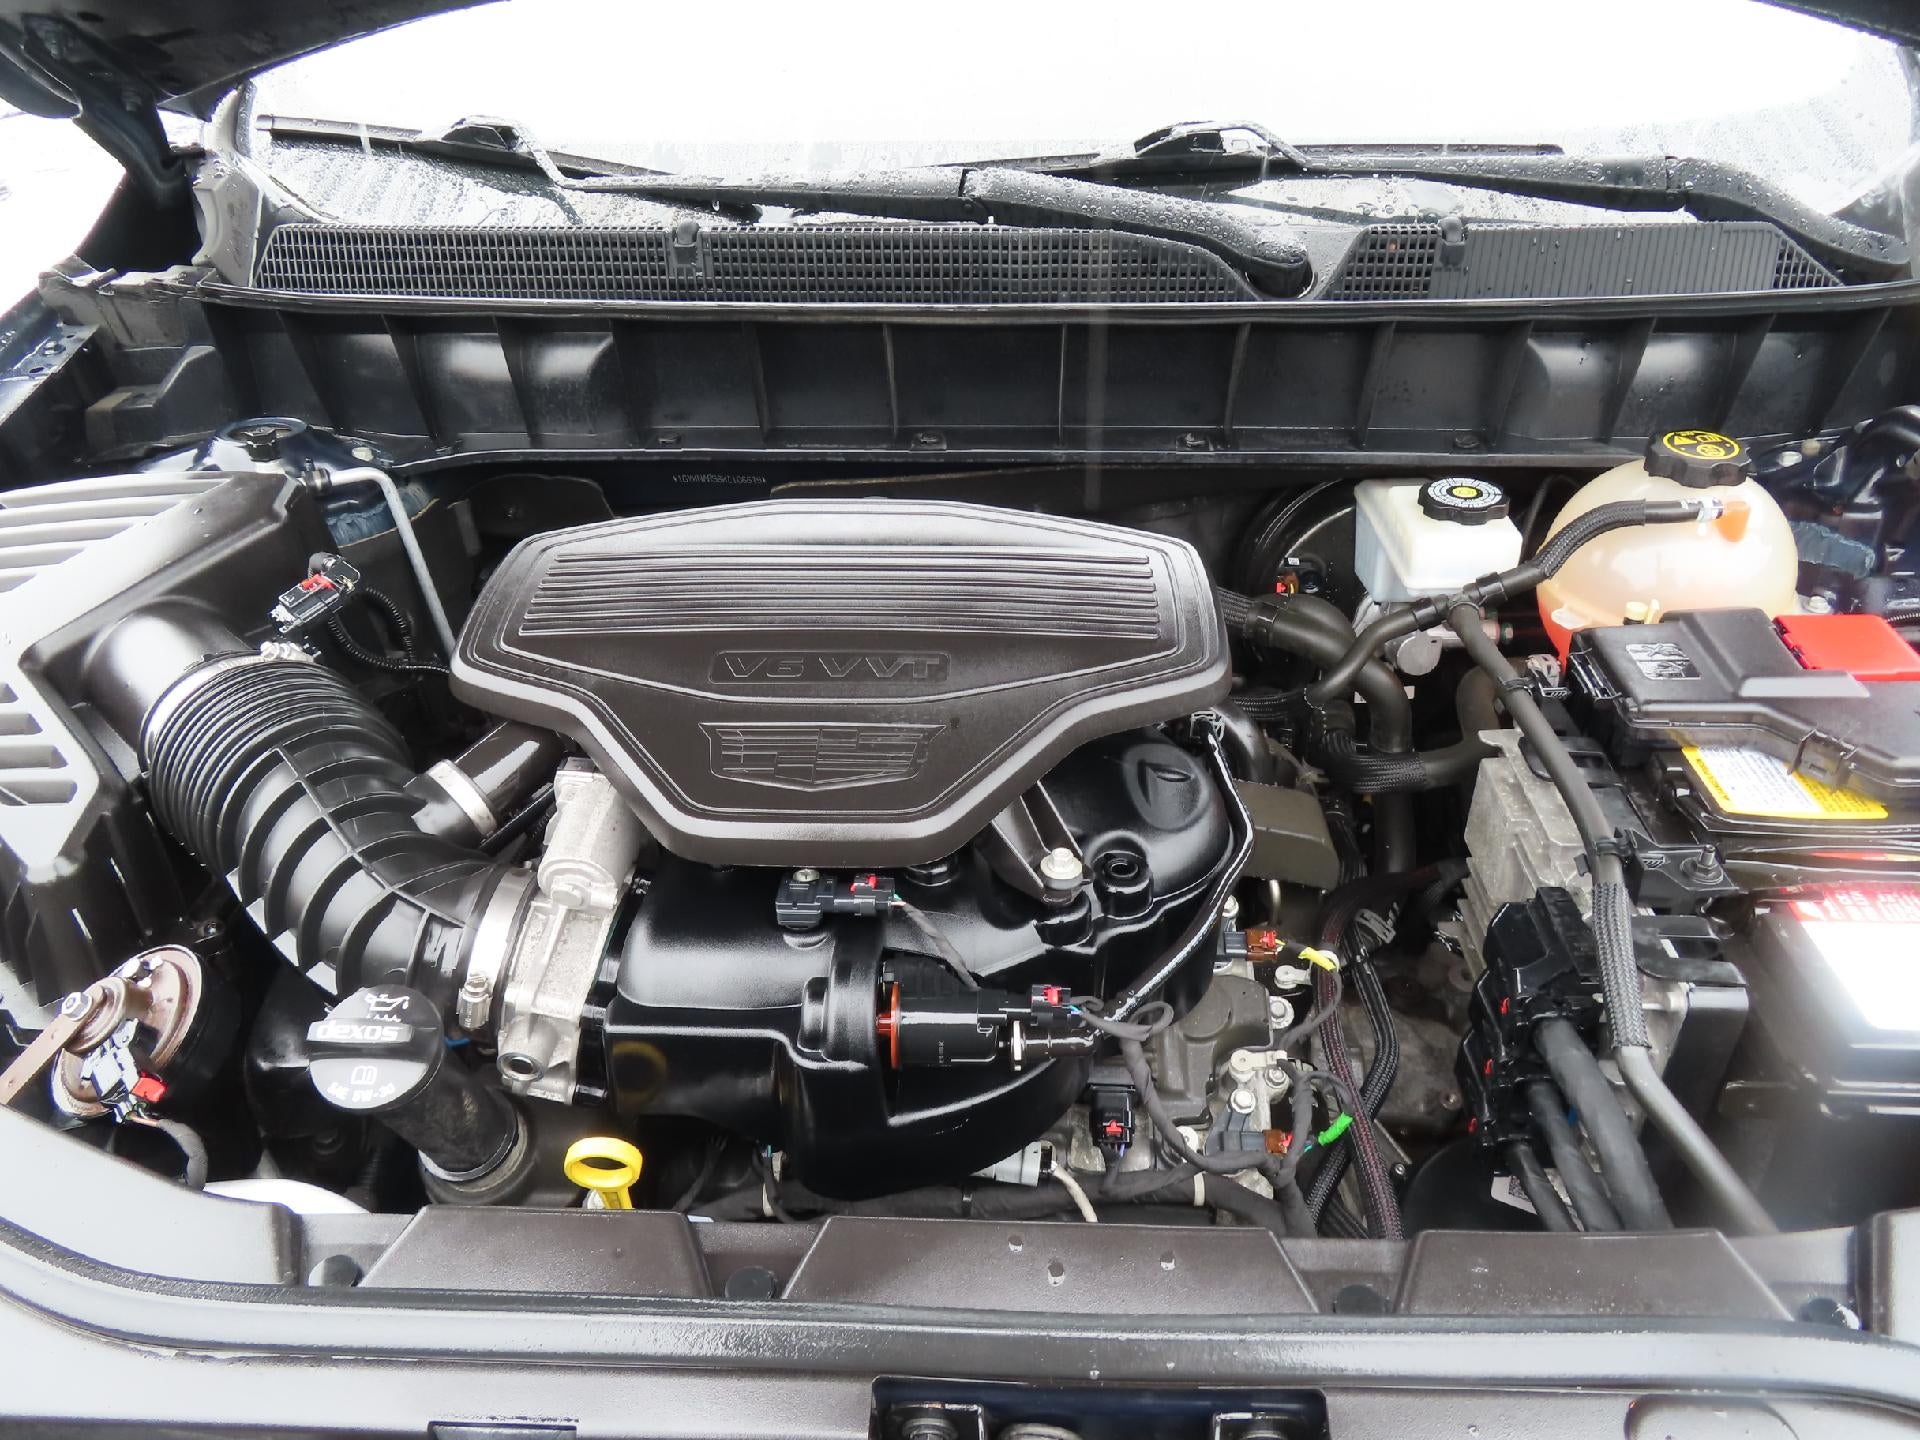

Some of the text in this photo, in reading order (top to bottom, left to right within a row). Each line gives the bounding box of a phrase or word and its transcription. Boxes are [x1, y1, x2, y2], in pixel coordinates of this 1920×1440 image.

[723, 657, 940, 679] V6 VVT
[316, 1019, 402, 1041] dexos
